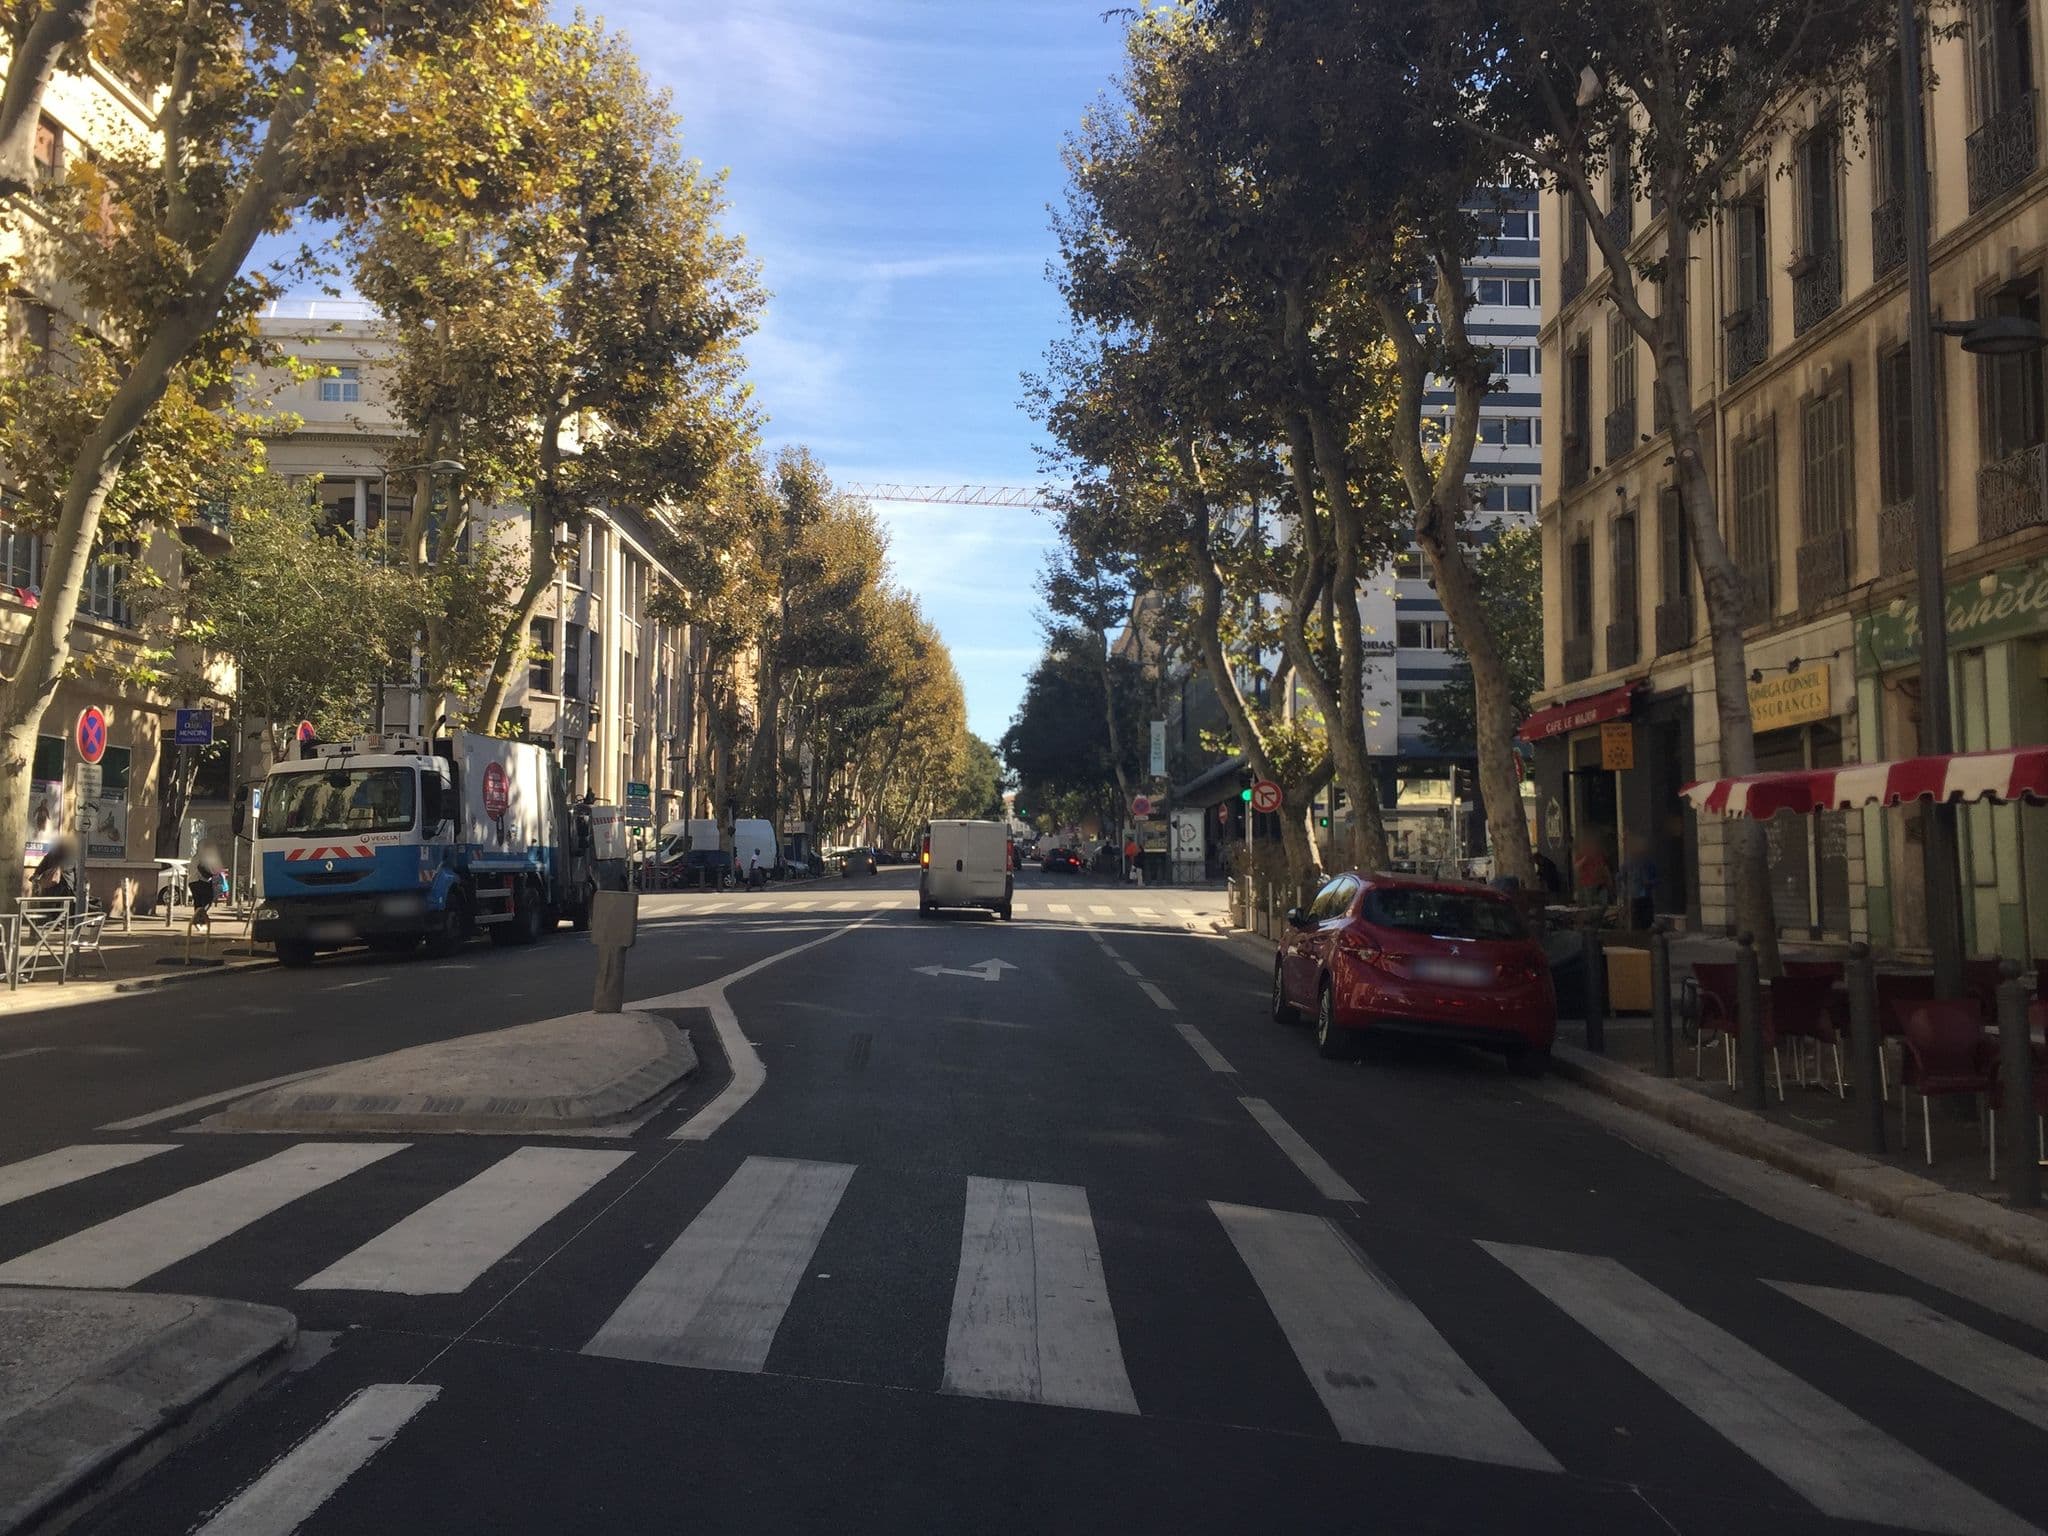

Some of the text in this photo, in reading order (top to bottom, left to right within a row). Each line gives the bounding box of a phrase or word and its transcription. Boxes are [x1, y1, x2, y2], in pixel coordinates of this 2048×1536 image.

[1904, 572, 2048, 646] anète
[1361, 640, 1395, 649] RIBAS
[1782, 671, 1821, 694] CONSEIL
[1563, 716, 1573, 729] LE
